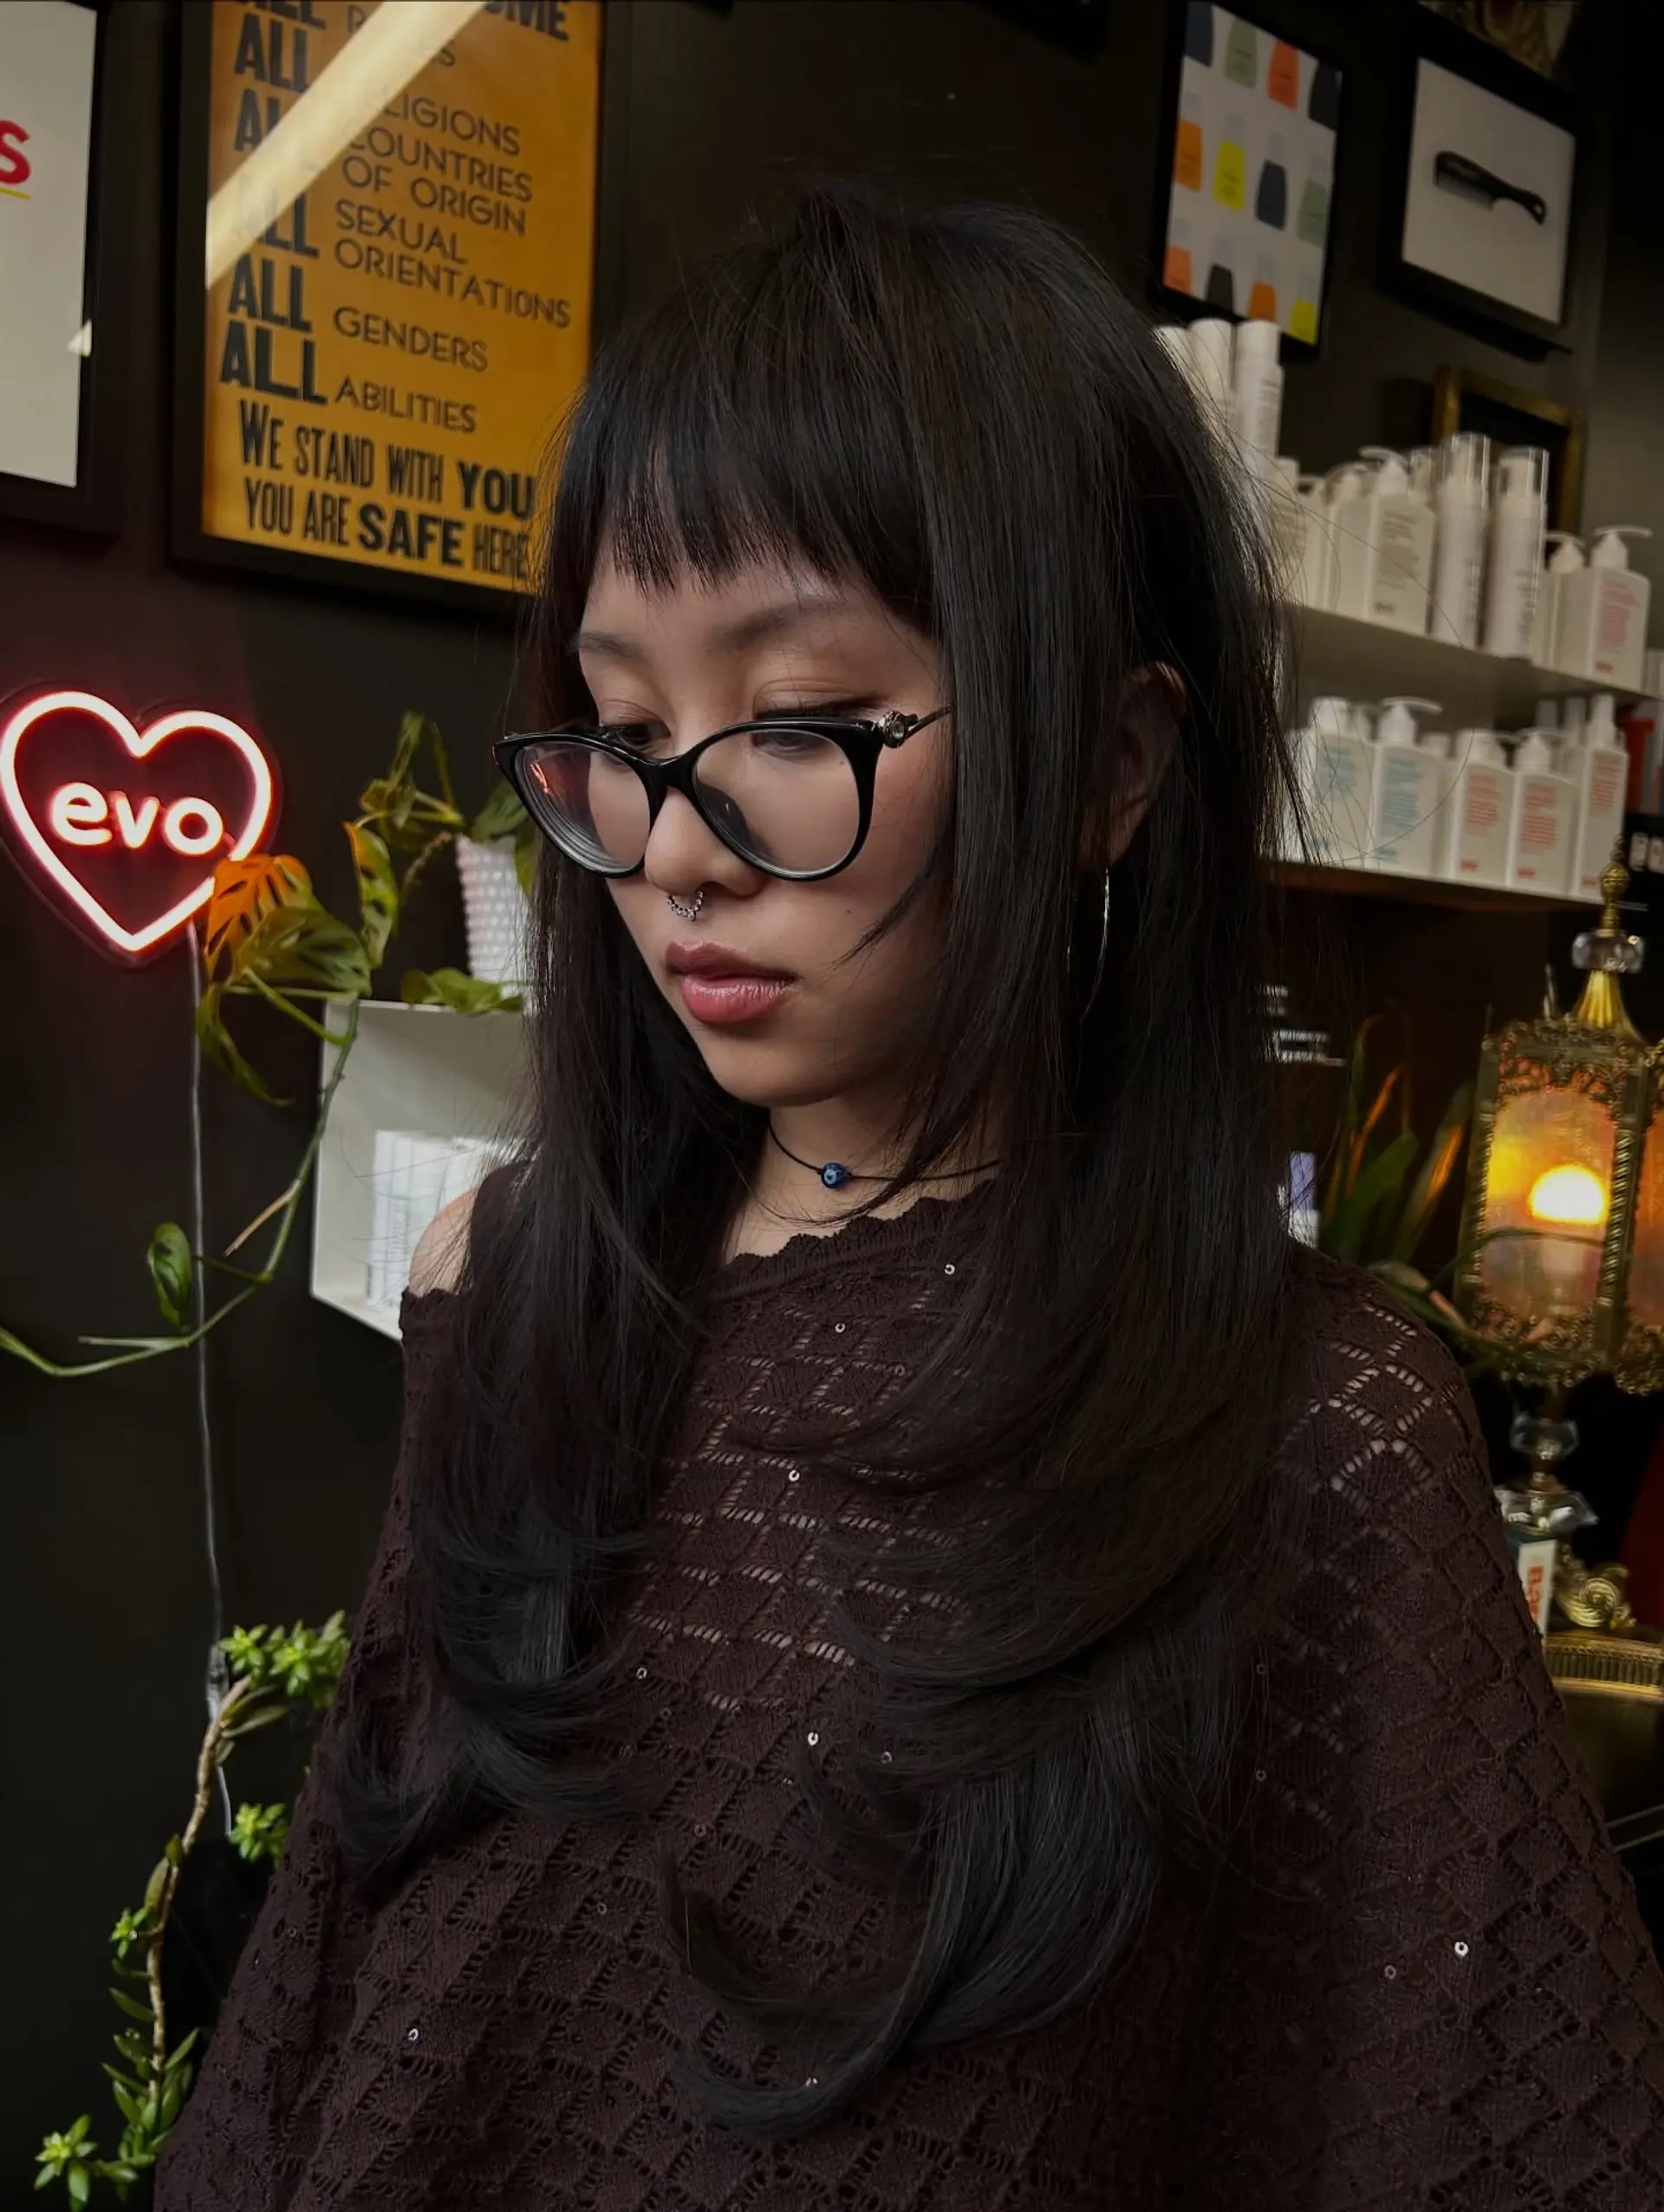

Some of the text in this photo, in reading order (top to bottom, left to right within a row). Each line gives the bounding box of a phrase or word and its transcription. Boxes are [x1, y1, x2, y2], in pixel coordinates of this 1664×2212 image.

[234, 12, 310, 94] ALL
[335, 198, 469, 265] SEXUAL
[341, 155, 526, 238] OF ORIGIN
[228, 254, 488, 372] ALL GENDERS
[334, 237, 572, 329] ORIENTATIONS
[220, 319, 477, 434] ALL ABILITIES
[239, 399, 536, 521] WE STAND WITH YOU
[245, 477, 295, 535] YOU
[304, 489, 350, 547] ARE
[358, 503, 465, 568] SAFE
[51, 782, 224, 856] evo
